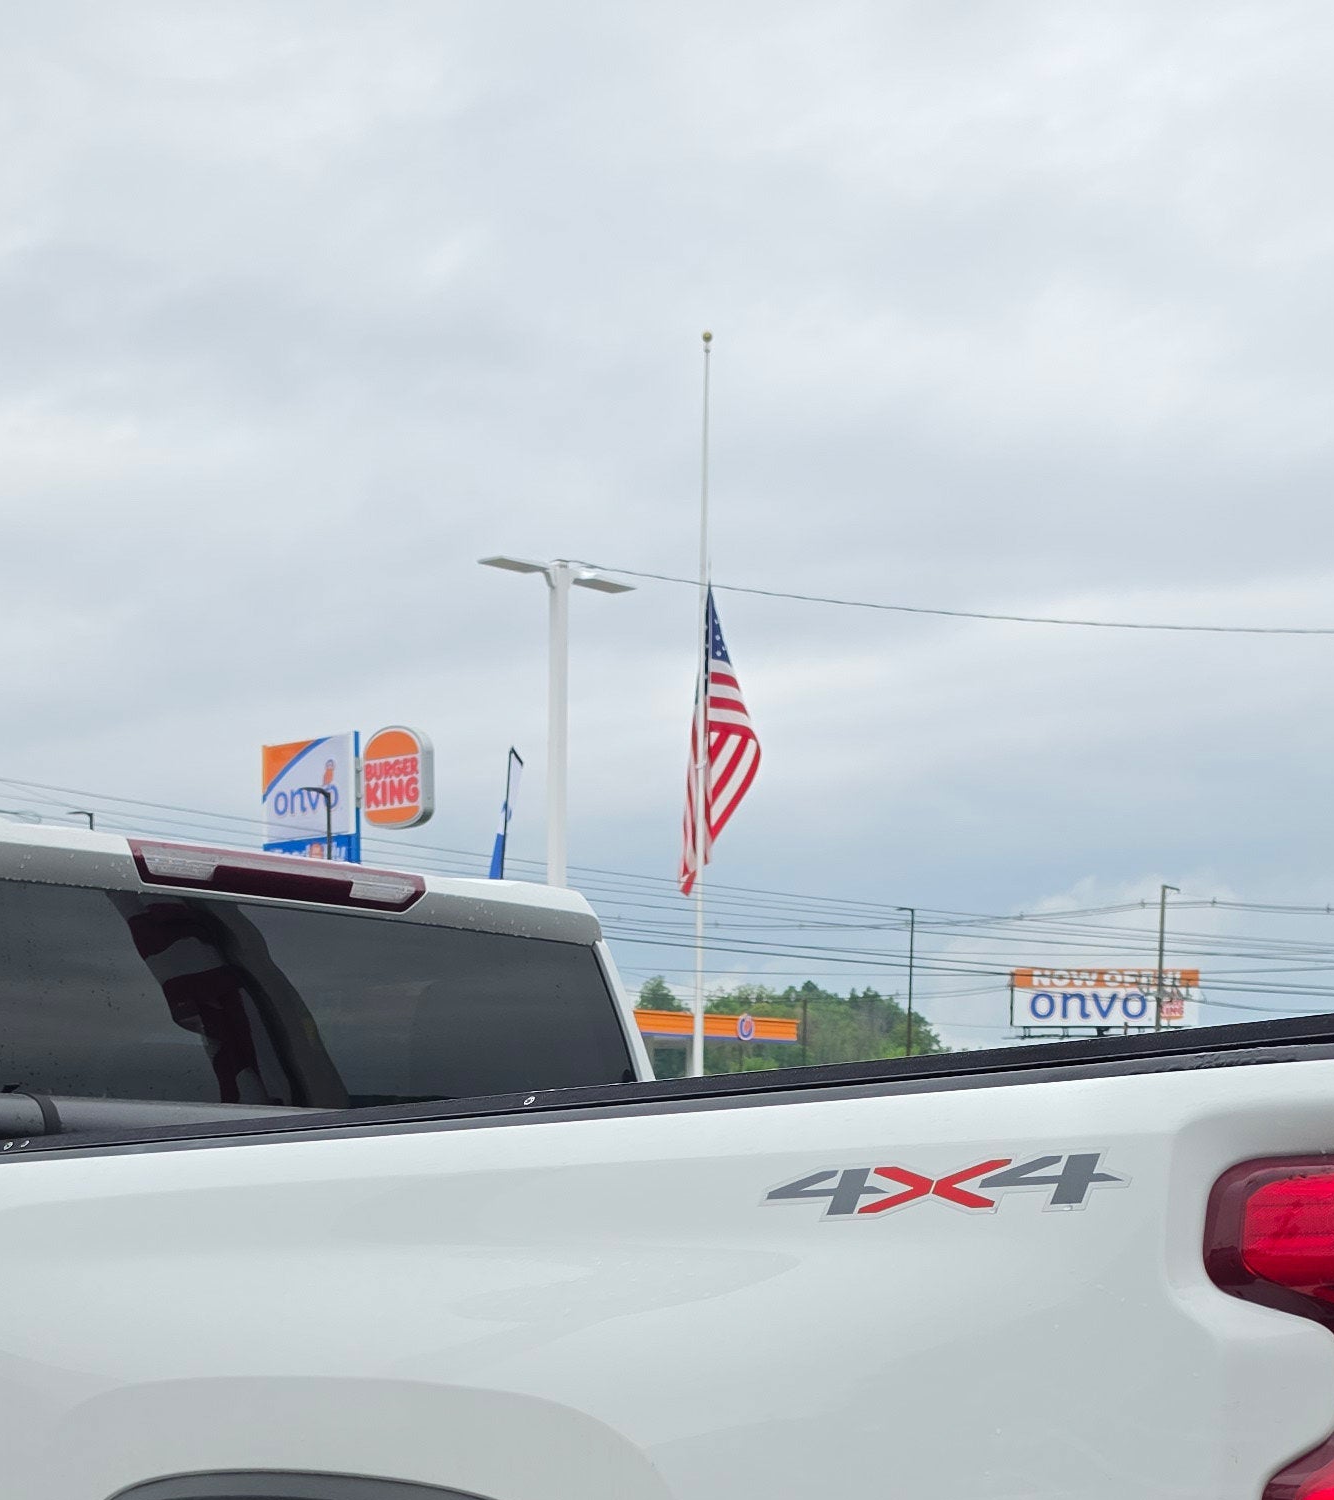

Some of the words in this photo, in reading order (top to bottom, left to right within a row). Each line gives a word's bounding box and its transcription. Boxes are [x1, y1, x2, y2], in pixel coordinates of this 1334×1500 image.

[365, 757, 418, 781] BURGER
[274, 784, 338, 815] onvo
[365, 776, 419, 808] KING
[1032, 969, 1098, 986] NOW
[1030, 992, 1146, 1019] onvo
